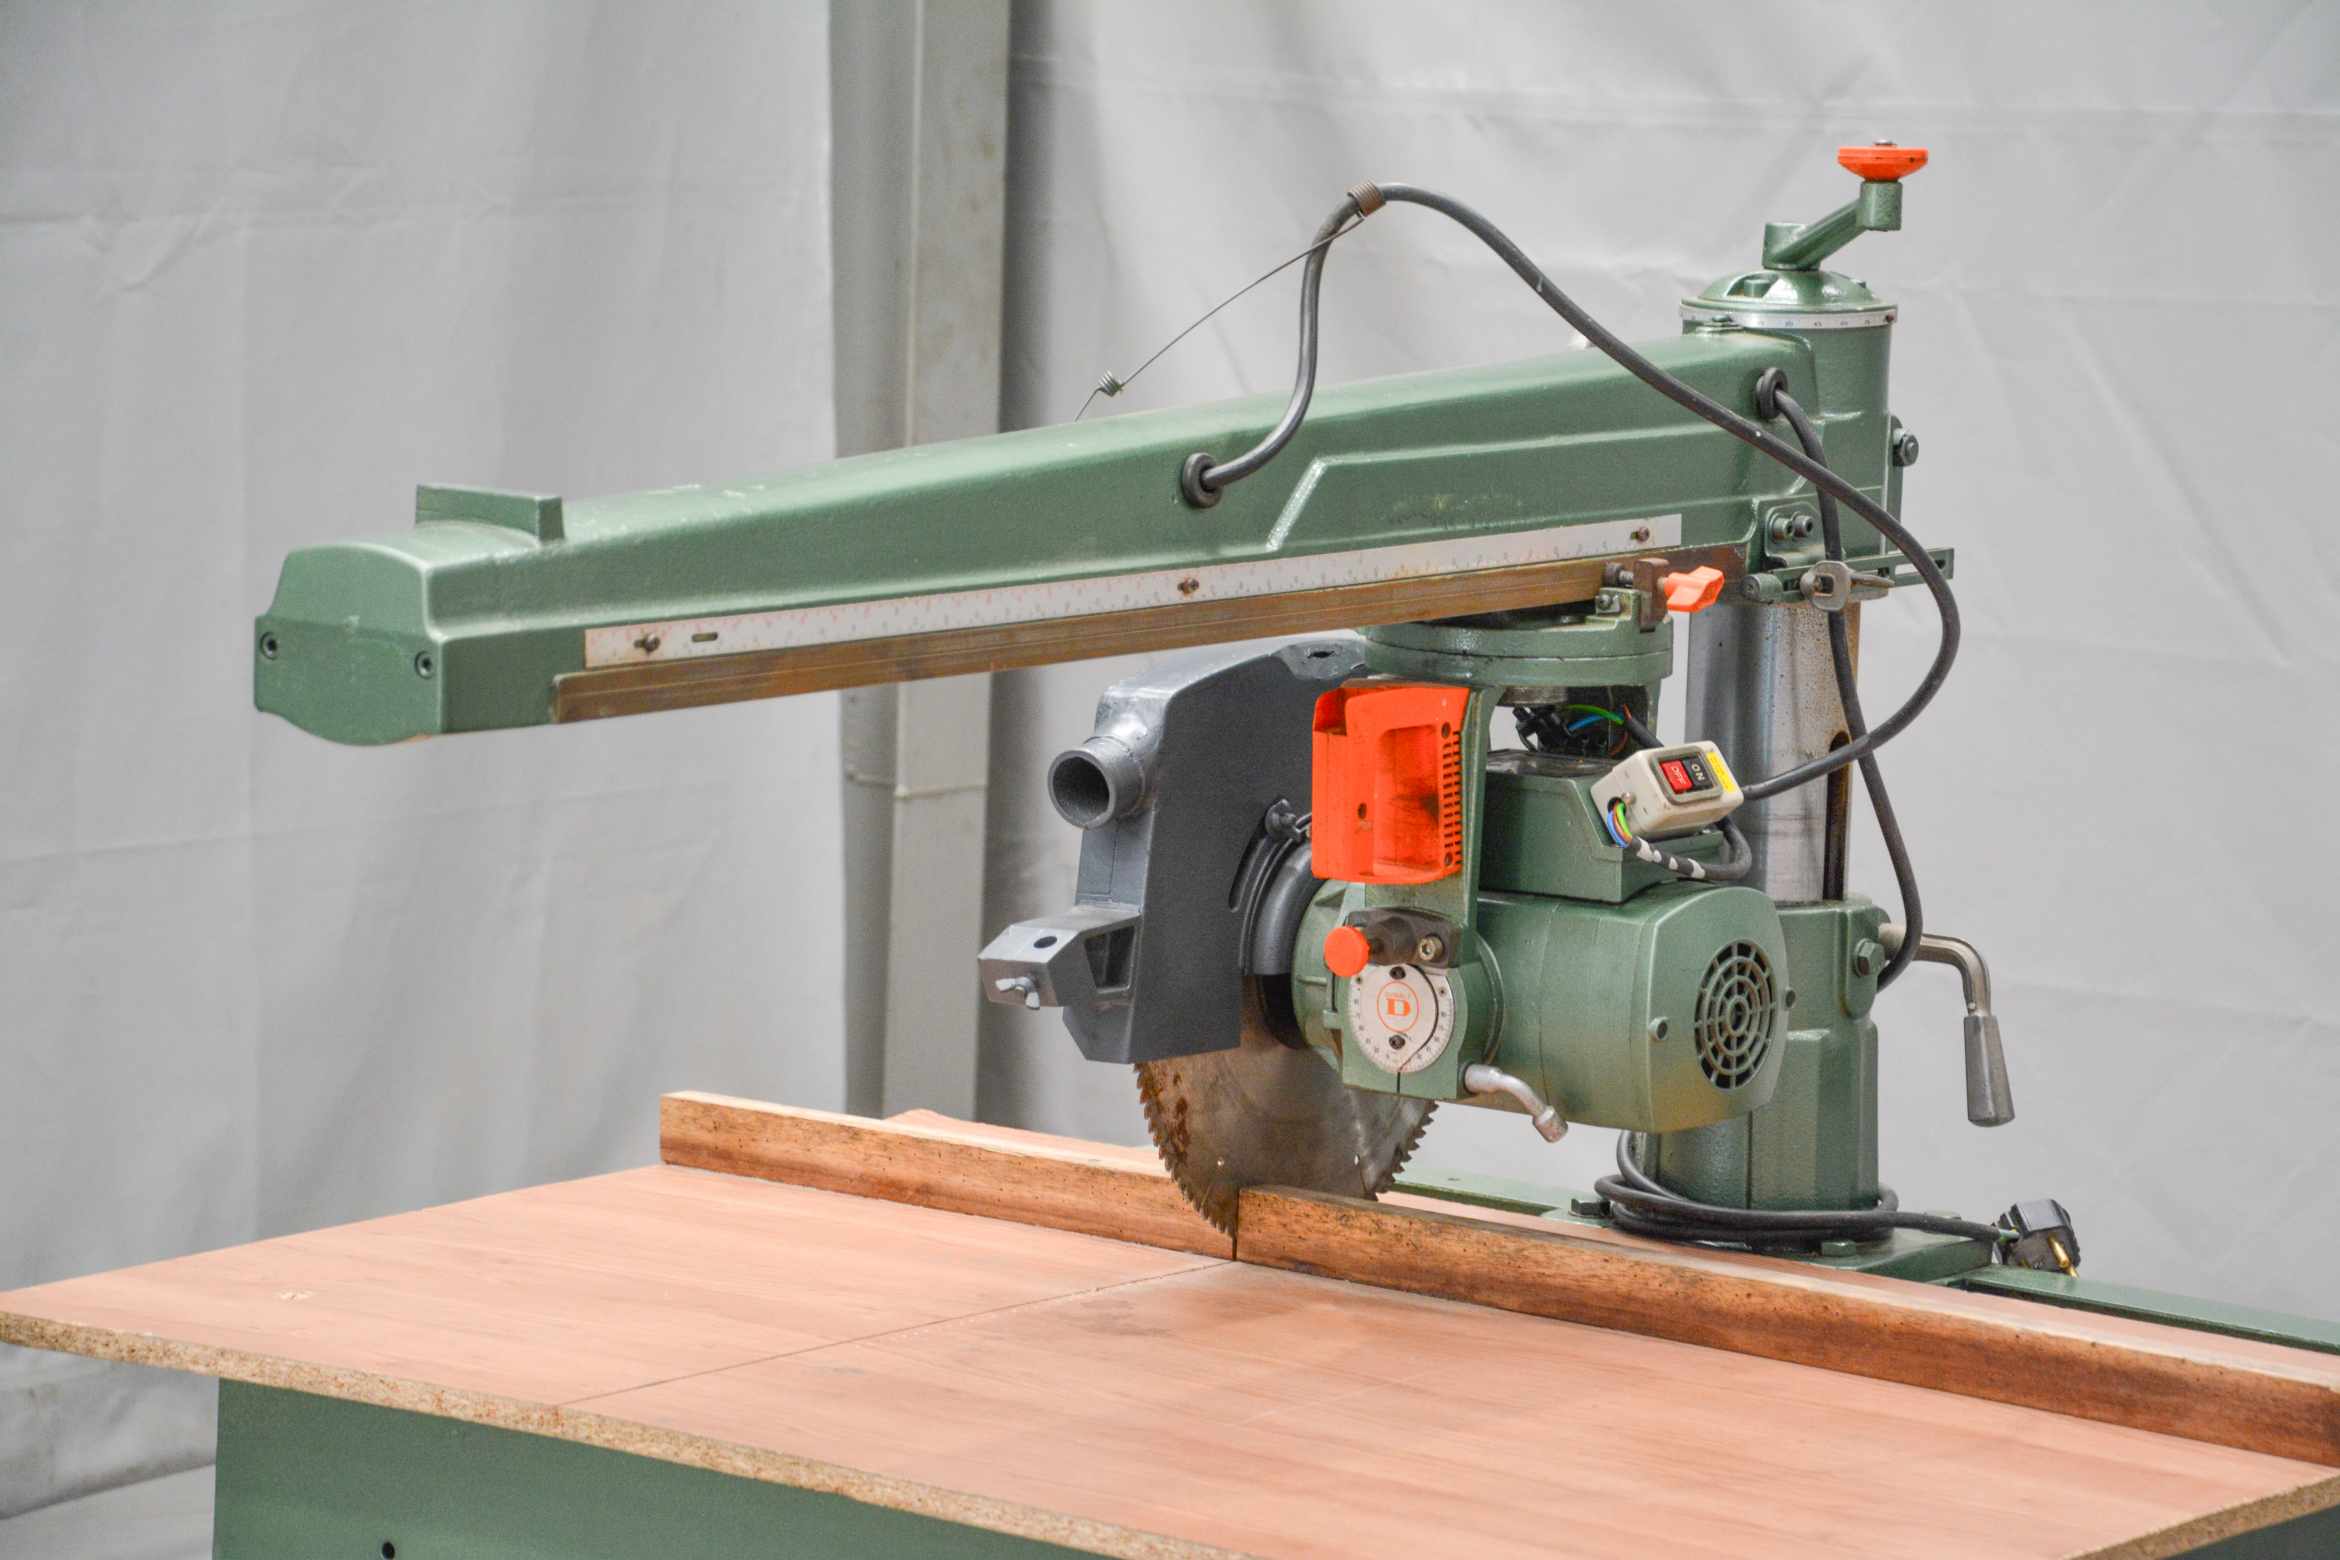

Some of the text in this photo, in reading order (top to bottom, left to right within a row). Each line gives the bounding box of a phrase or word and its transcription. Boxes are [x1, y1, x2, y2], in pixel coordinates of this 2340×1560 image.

[1671, 766, 1686, 784] OFF
[1691, 763, 1705, 781] ON
[1386, 998, 1411, 1016] D
